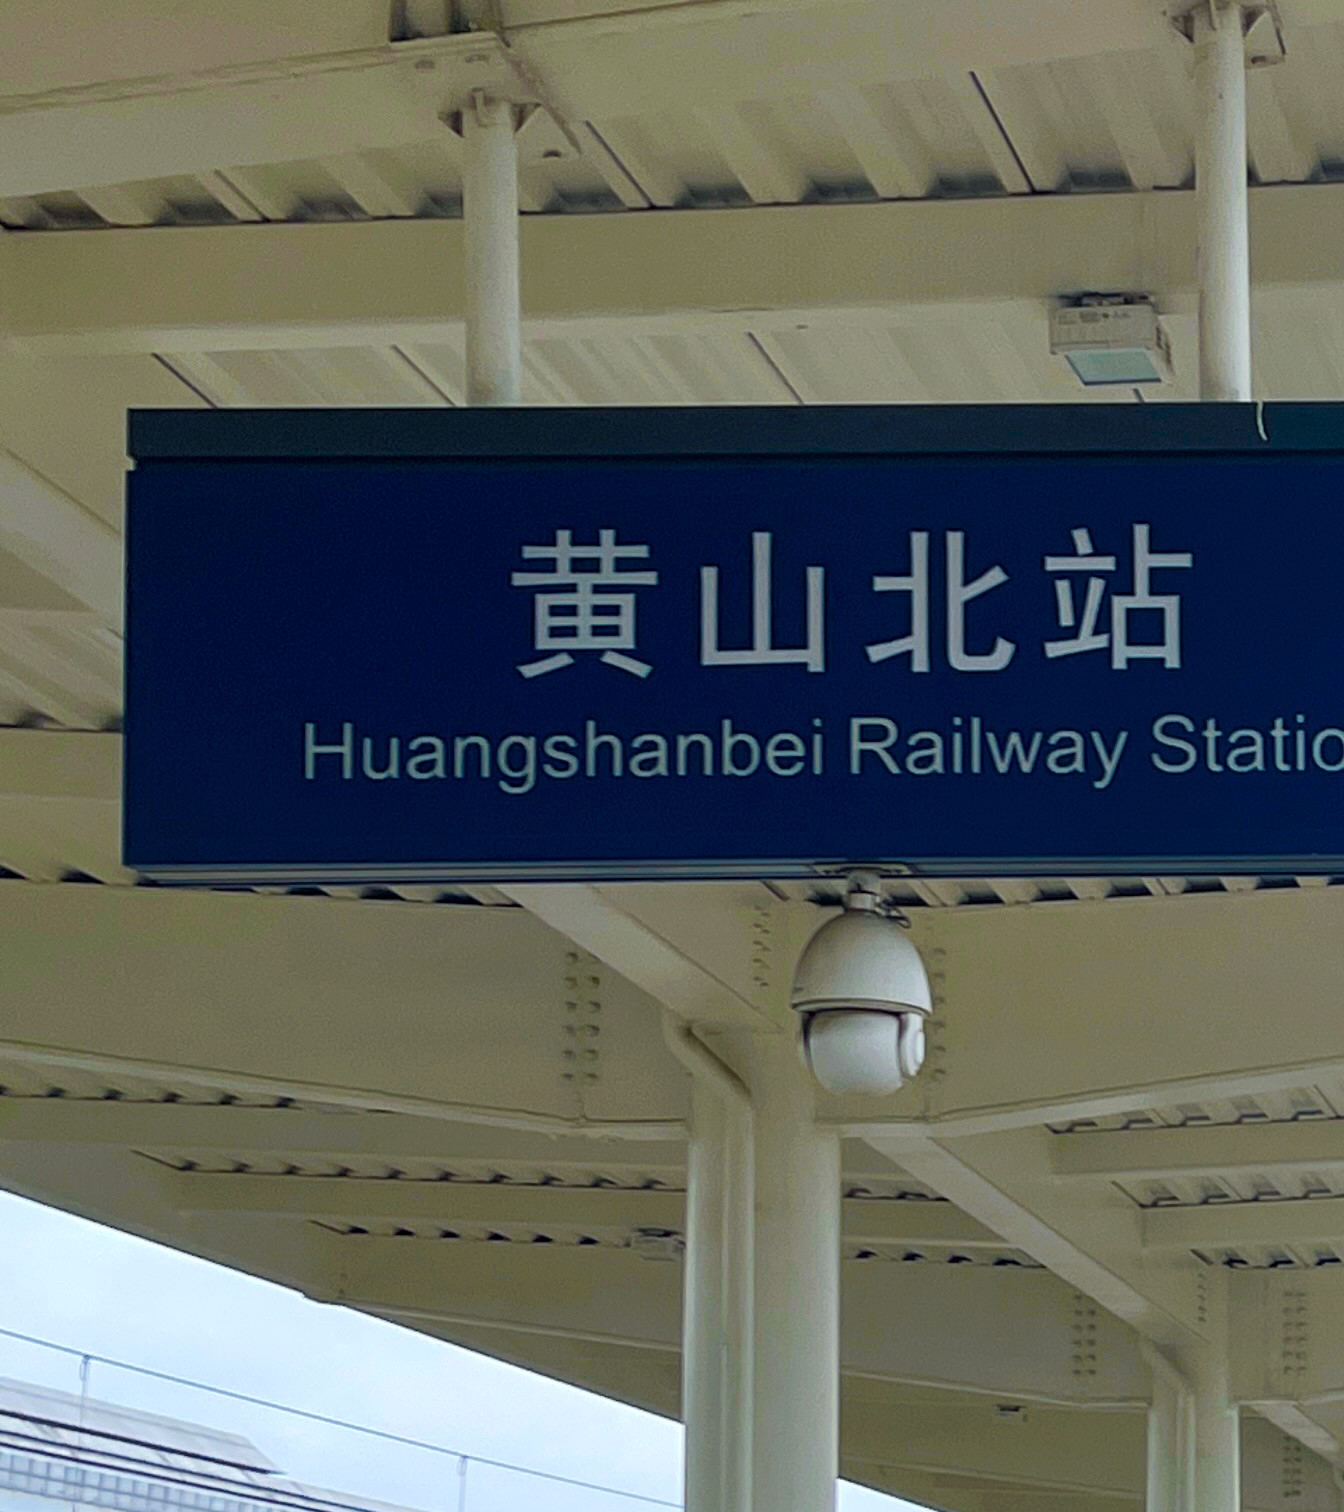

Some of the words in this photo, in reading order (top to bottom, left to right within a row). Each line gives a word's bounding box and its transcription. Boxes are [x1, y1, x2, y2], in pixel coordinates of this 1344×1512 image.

[510, 523, 1194, 679] 黄山北站
[303, 717, 824, 795] Huangshanbei
[849, 715, 1129, 790] Railway
